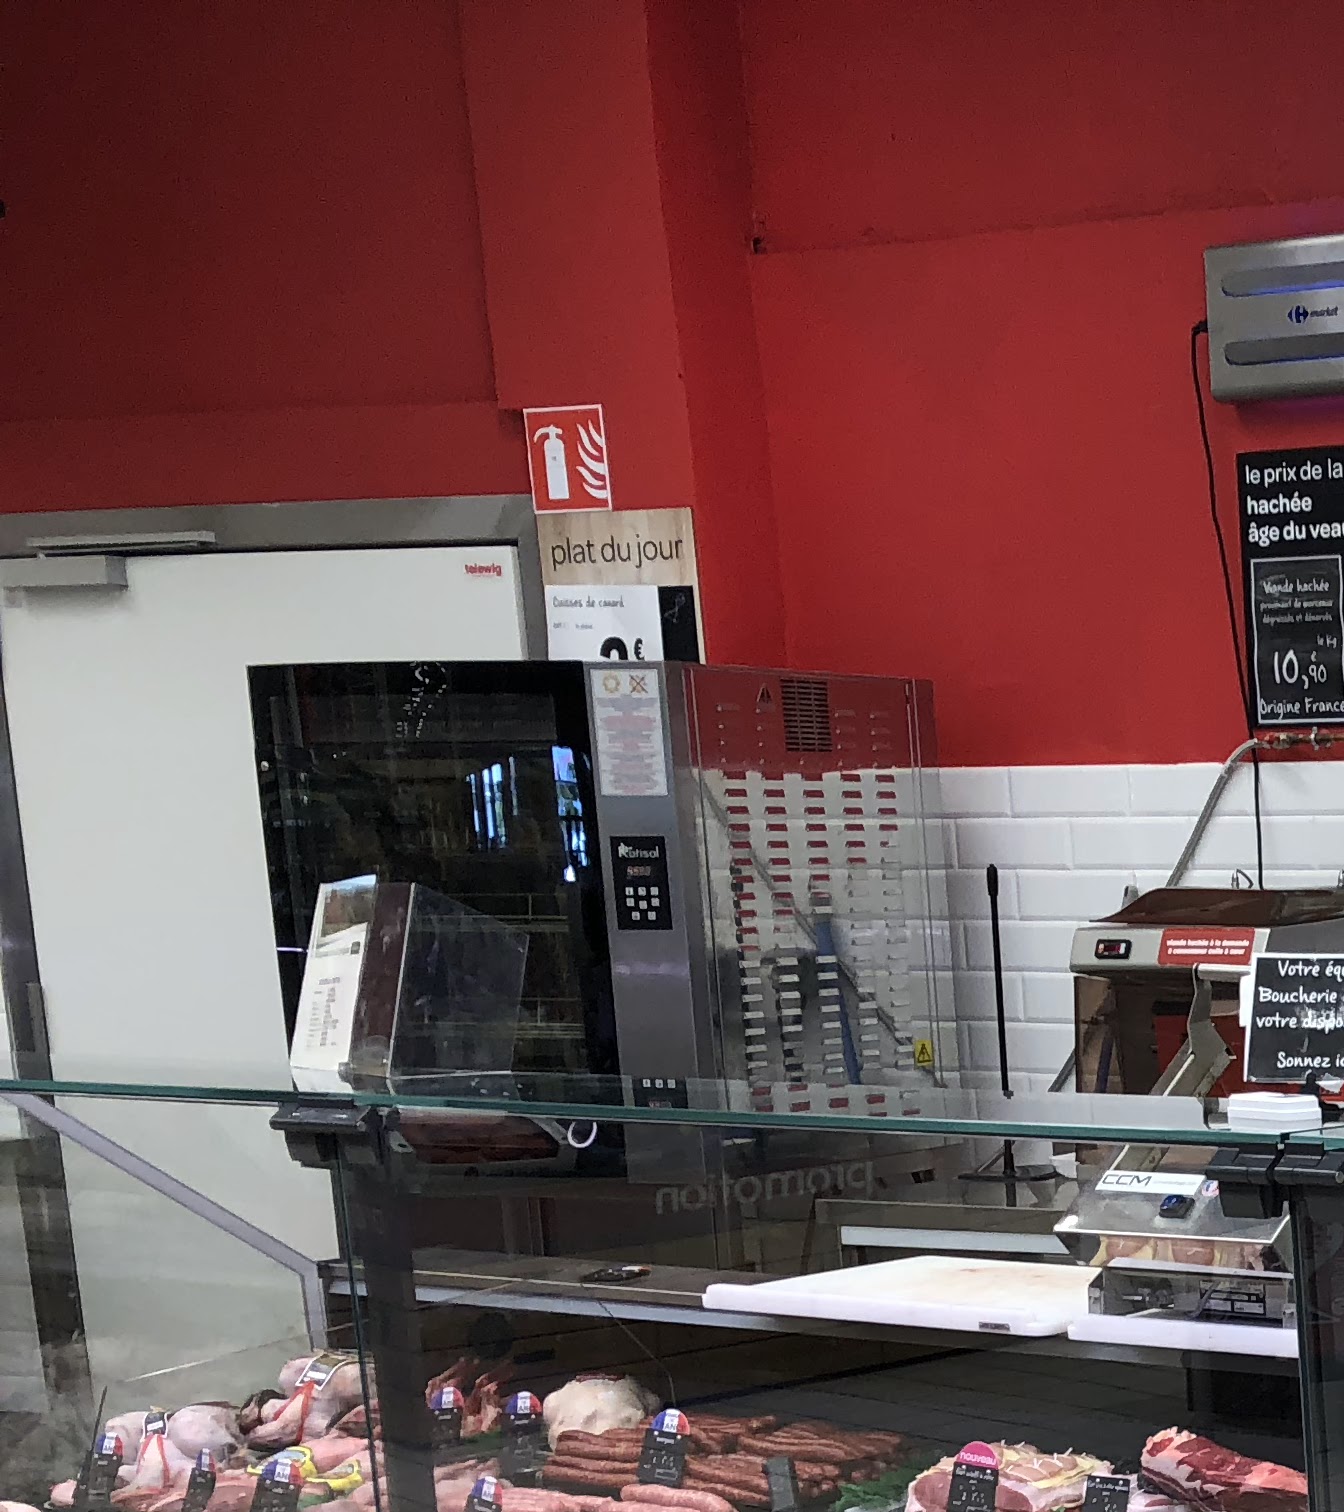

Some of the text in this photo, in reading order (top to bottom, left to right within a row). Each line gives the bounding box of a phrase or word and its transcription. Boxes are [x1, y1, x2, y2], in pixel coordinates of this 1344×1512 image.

[1245, 464, 1260, 484] le
[1264, 462, 1297, 488] prix
[1299, 460, 1322, 481] de
[1327, 457, 1343, 480] la
[1246, 491, 1313, 515] hachée
[1248, 521, 1280, 547] âge
[1282, 520, 1306, 540] du
[551, 534, 683, 571] plat du jour
[1262, 577, 1330, 595] Viande hachée
[1260, 699, 1300, 720] Origine
[1278, 959, 1320, 978] Votre
[1259, 987, 1337, 1003] Boucherie
[1256, 1014, 1297, 1029] votre
[1277, 1051, 1331, 1069] Sonnez
[1102, 1174, 1152, 1187] CCM
[960, 1452, 996, 1466] nouveau
